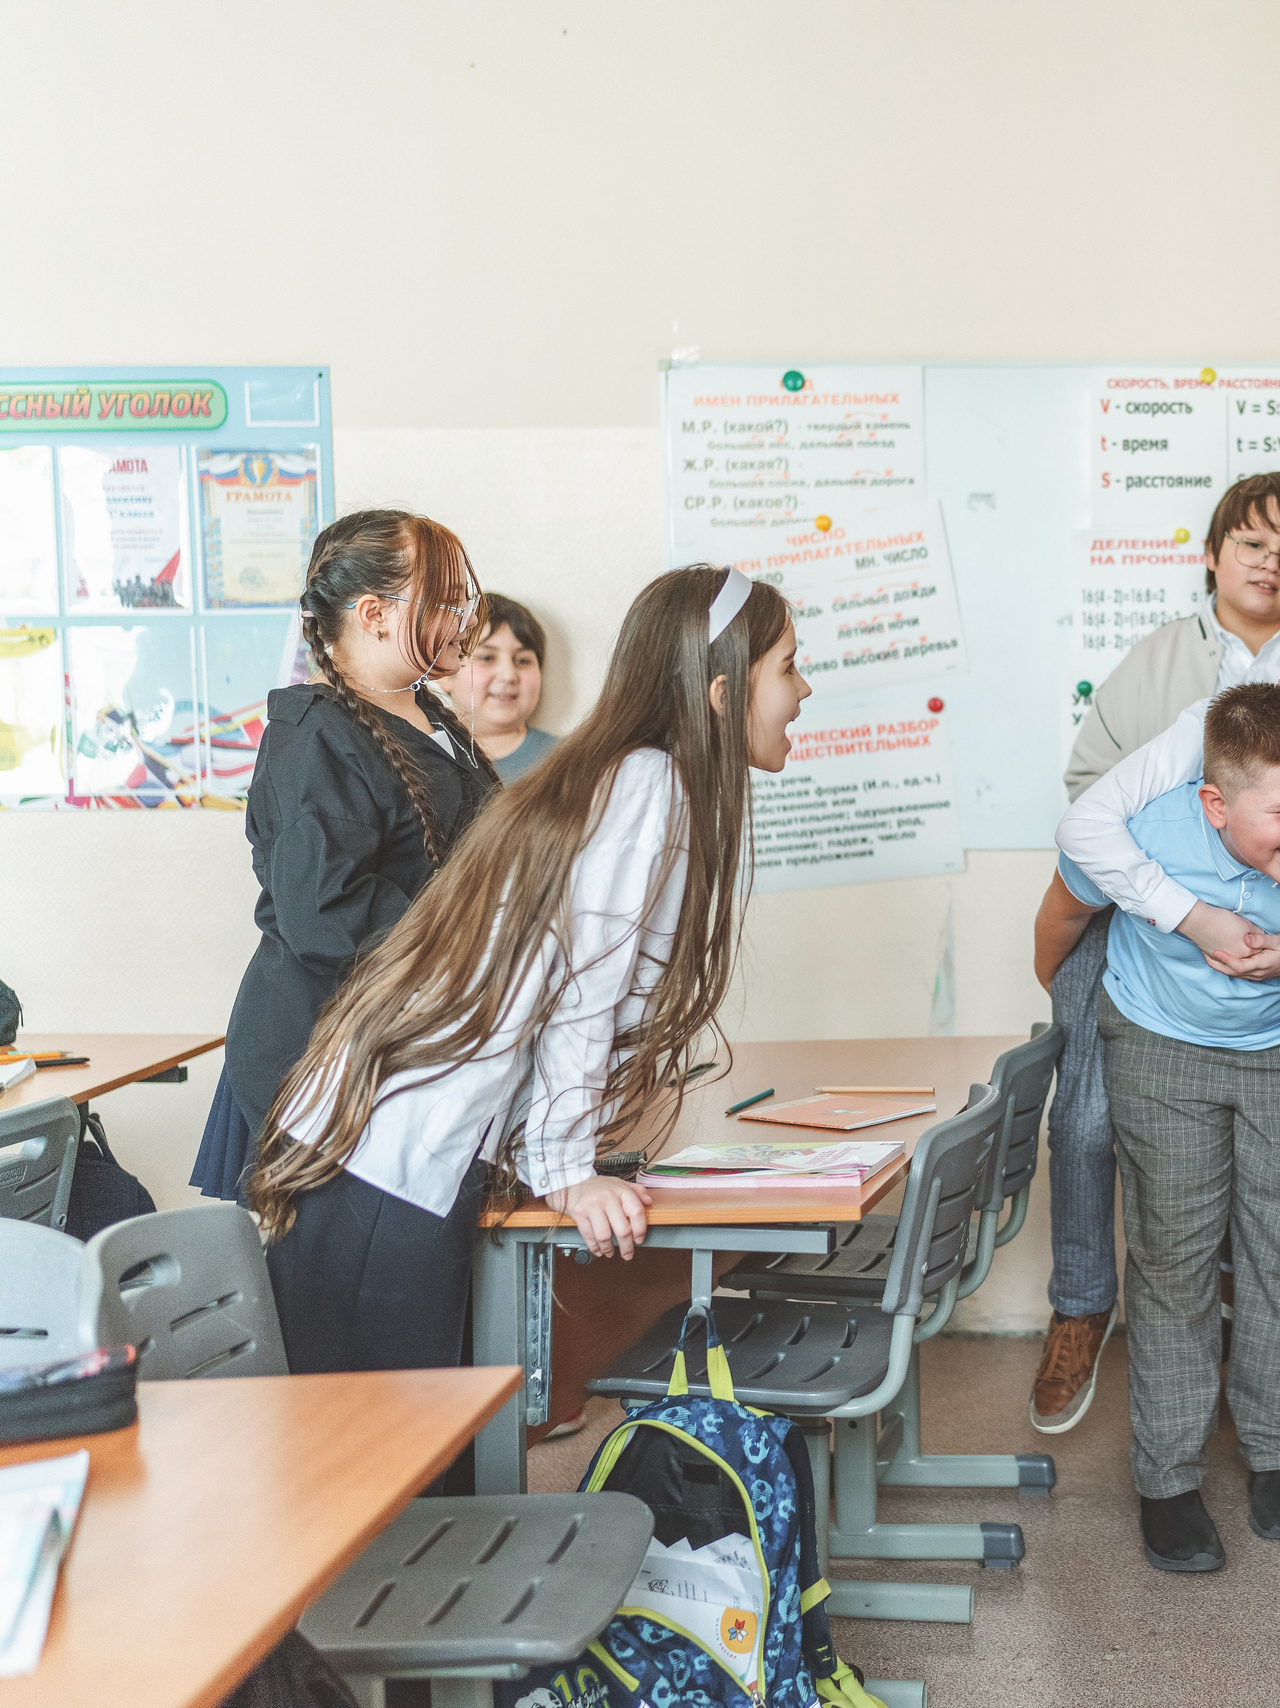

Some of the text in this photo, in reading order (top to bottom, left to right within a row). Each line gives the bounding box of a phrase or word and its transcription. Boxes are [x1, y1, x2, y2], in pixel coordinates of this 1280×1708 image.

[1107, 379, 1169, 389] СКОРОСТЬ,
[98, 391, 212, 419] УГОЛОК
[693, 393, 899, 407] ИМЕН ПРИЛАГАТЕЛЬНЫХ
[1237, 400, 1246, 415] V
[1100, 399, 1110, 413] V
[1126, 402, 1192, 418] скорость
[682, 421, 717, 434] М.Р.
[724, 420, 788, 436] (какой?)
[1122, 439, 1168, 455] время
[1237, 438, 1243, 452] t
[683, 458, 719, 472] Ж.Р.
[726, 458, 789, 473] (какая?)
[1101, 472, 1110, 488] S
[1126, 474, 1212, 491] расстояние
[226, 491, 292, 502] ГРАМОТА
[733, 495, 797, 511] (какое?)
[786, 528, 844, 546] ЧИСЛО
[1091, 539, 1179, 551] ДЕЛЕНИЕ
[767, 532, 925, 569] ПРИЛАГАТЕЛЬНЫХ
[883, 546, 928, 564] ЧИСЛО
[1091, 555, 1115, 565] НА
[893, 586, 936, 604] дожди
[888, 616, 919, 631] ночи
[843, 649, 899, 669] высокие
[903, 638, 958, 658] деревья
[877, 718, 939, 735] РАЗБОР
[815, 783, 858, 797] форма
[855, 800, 950, 818] одушевленное
